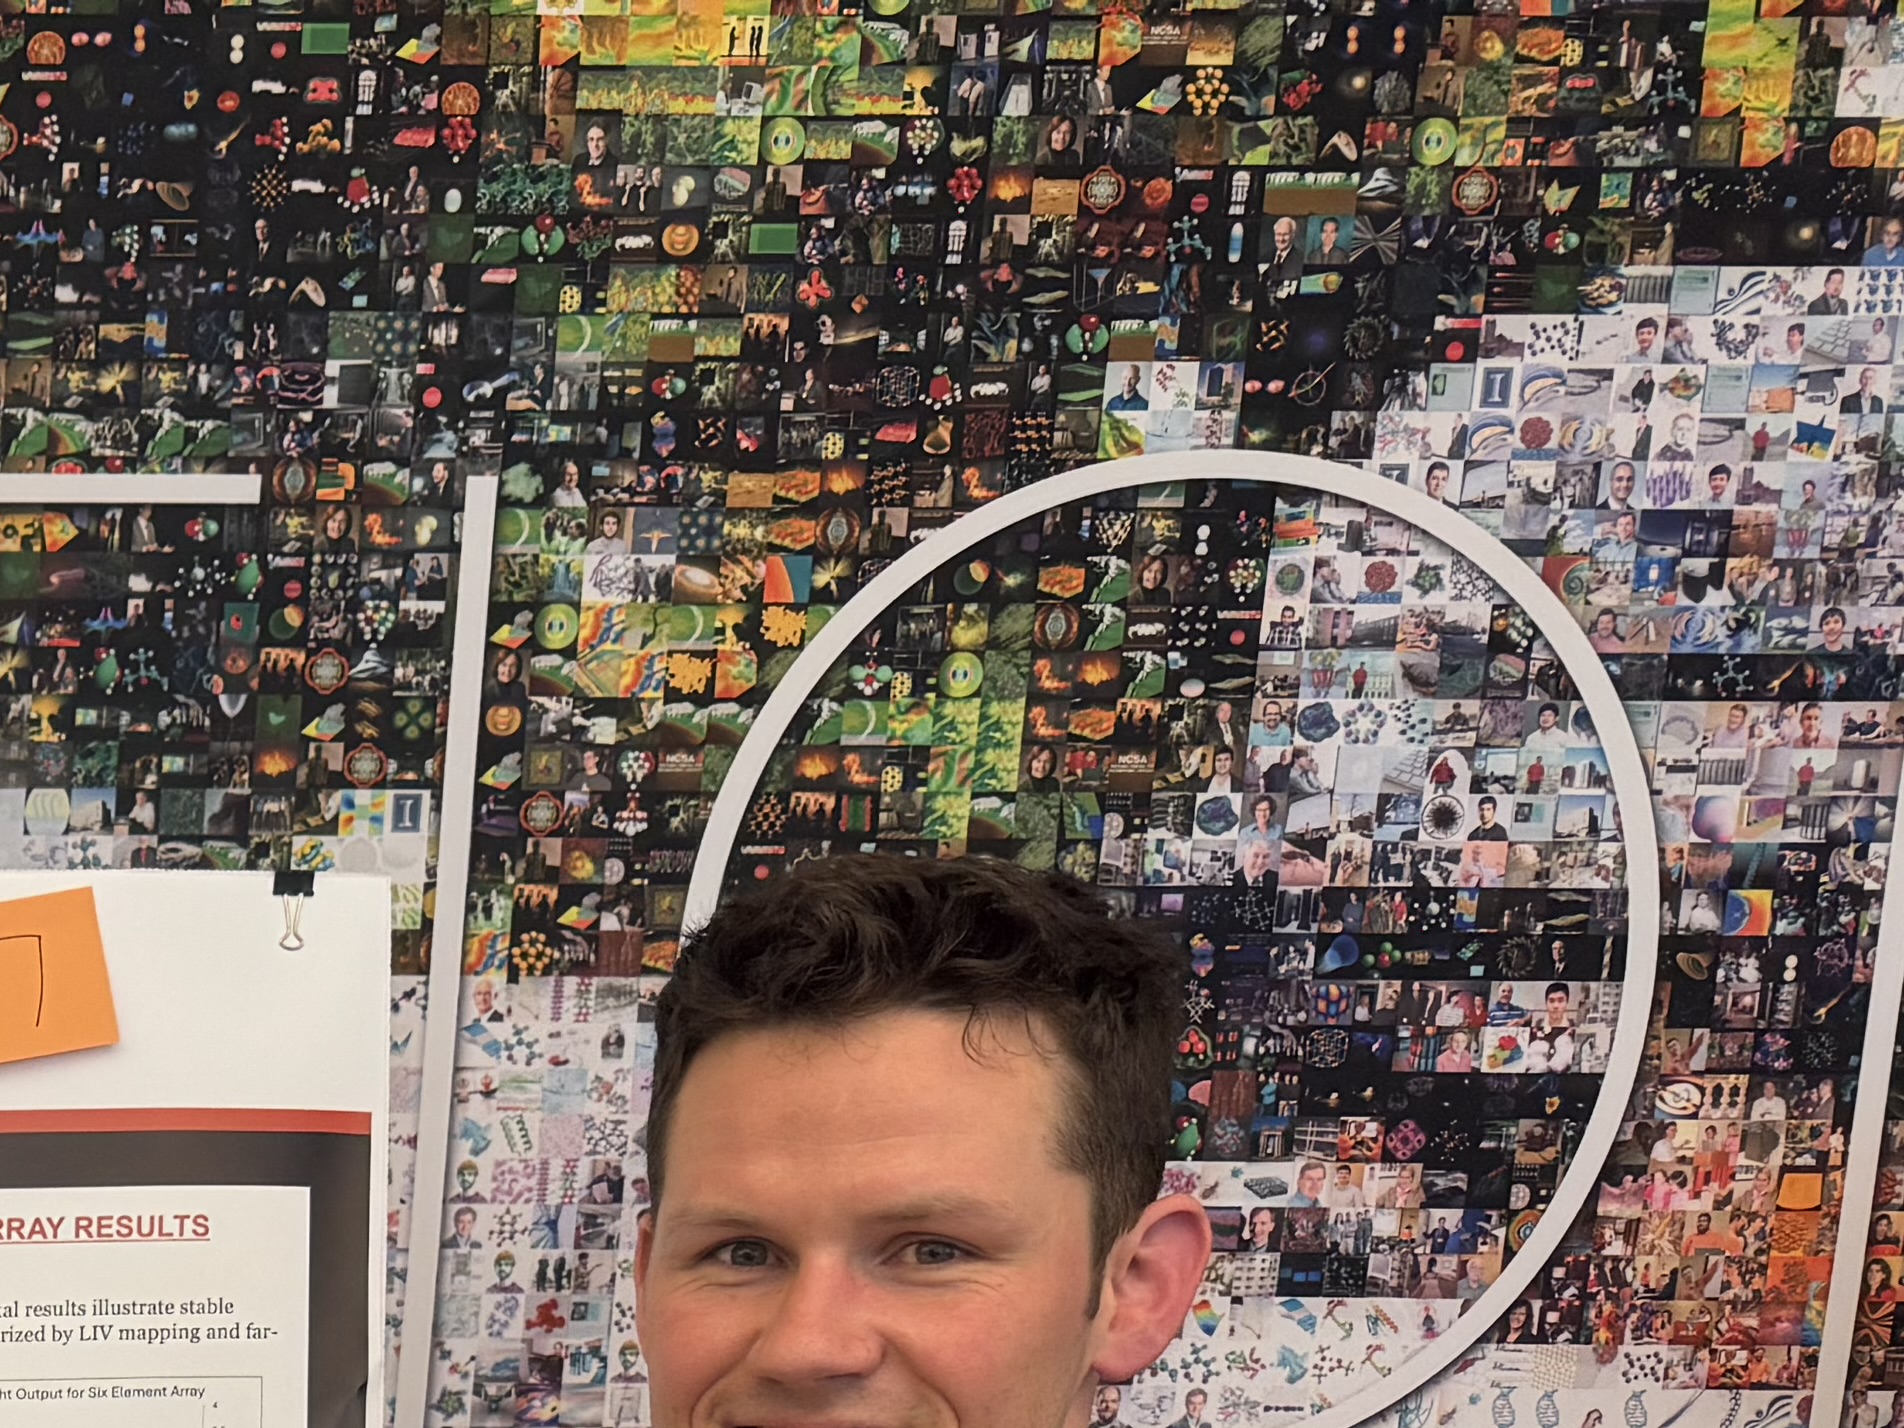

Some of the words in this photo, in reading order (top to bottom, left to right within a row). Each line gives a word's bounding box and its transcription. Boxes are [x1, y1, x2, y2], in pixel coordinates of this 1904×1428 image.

[74, 1213, 210, 1241] RESULTS
[15, 1386, 63, 1403] Output
[66, 1385, 86, 1400] for
[87, 1385, 108, 1400] Six
[111, 1384, 168, 1400] Element
[169, 1384, 206, 1401] Array
